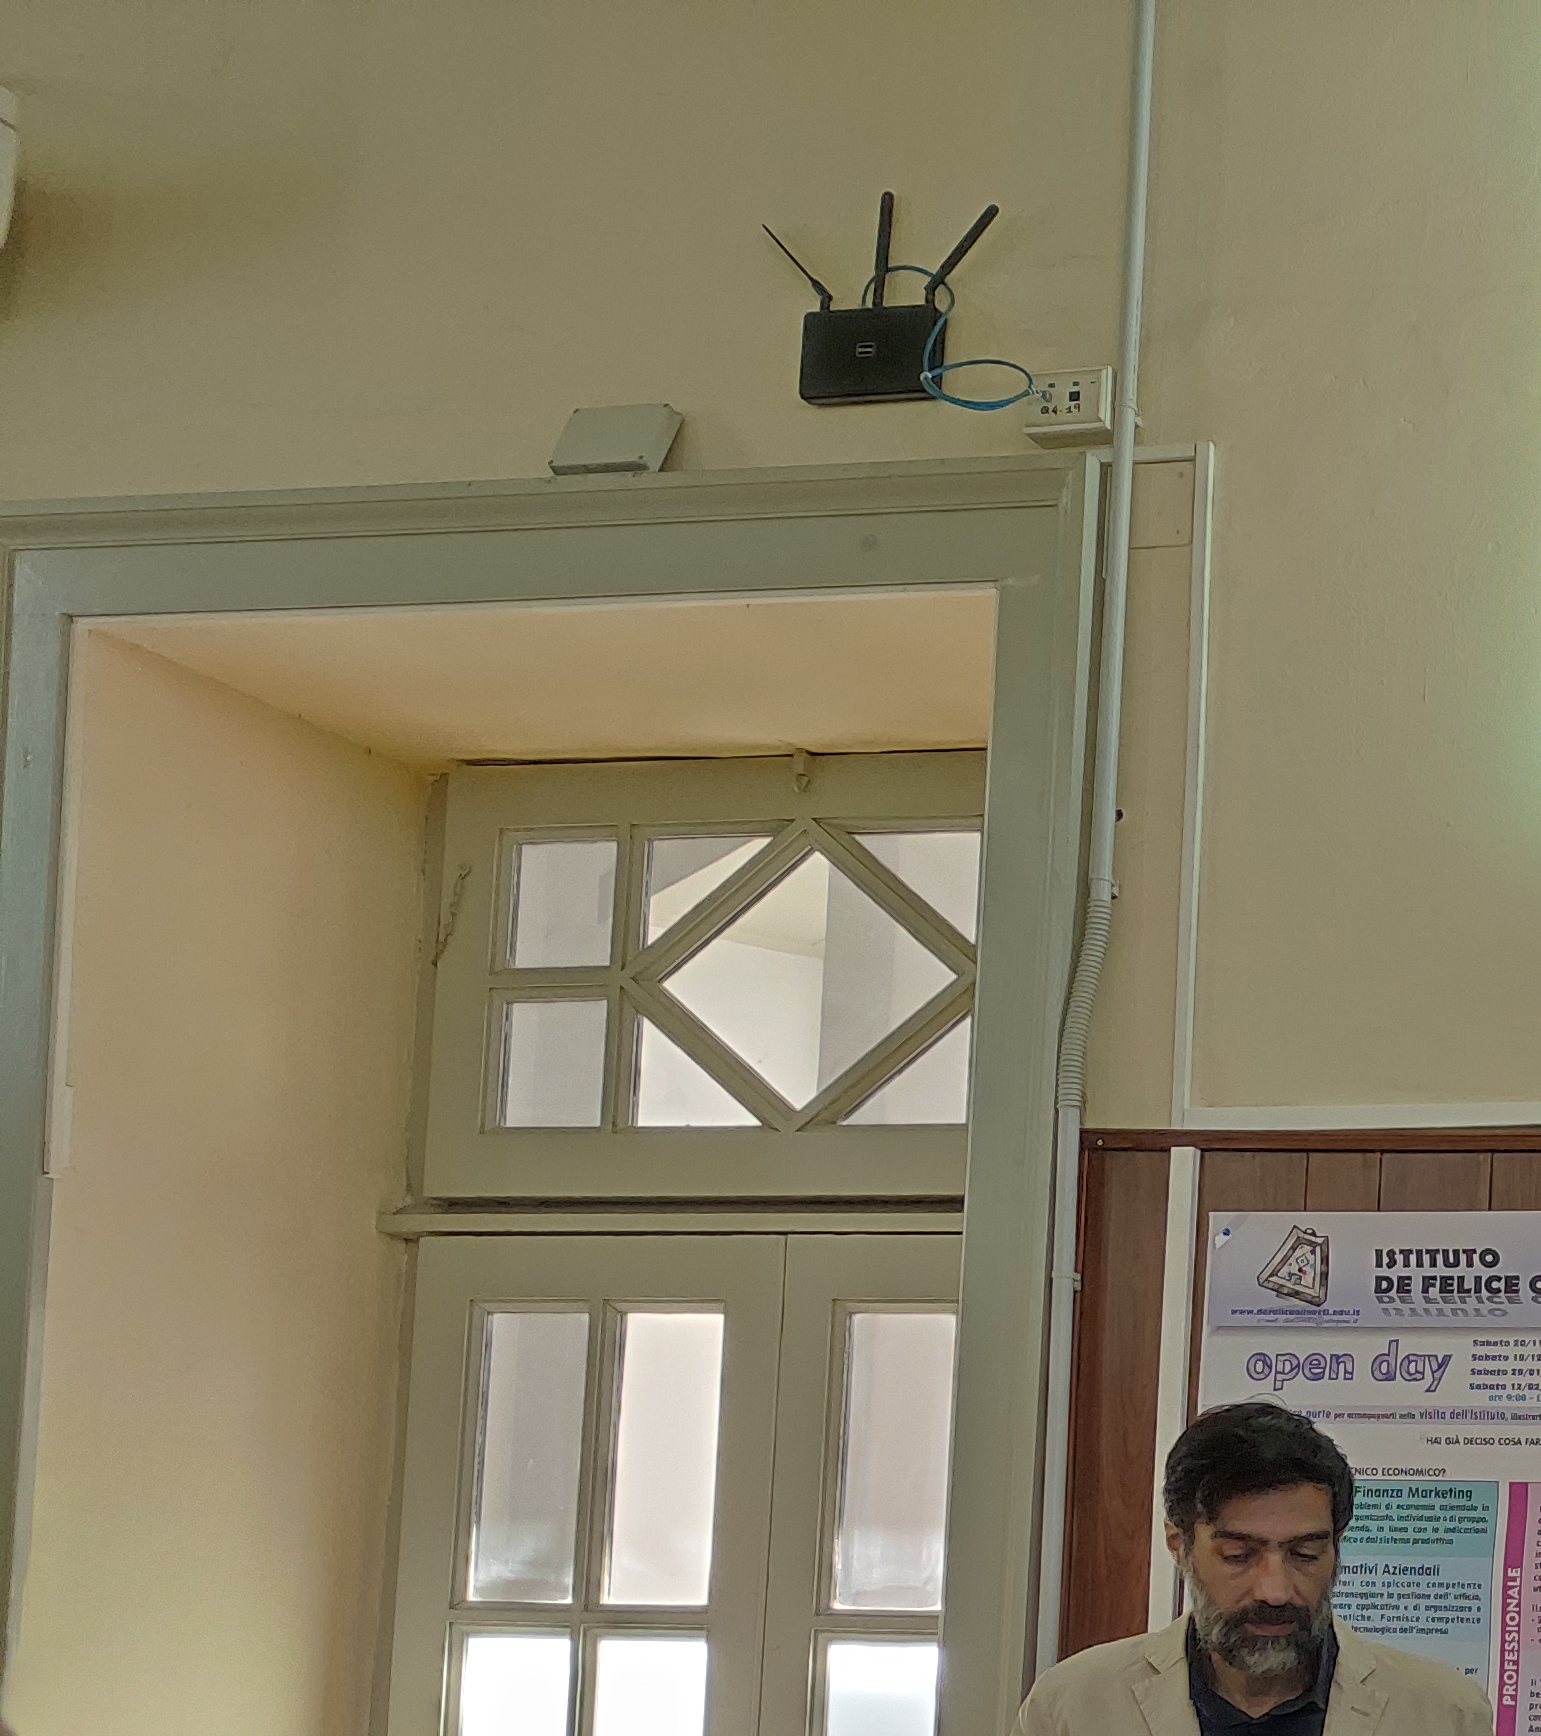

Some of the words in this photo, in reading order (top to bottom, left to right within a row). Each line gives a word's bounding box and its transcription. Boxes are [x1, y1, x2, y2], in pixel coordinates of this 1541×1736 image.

[1374, 1247, 1501, 1269] ISTITUTO
[1373, 1274, 1413, 1295] DE
[1420, 1274, 1521, 1295] FELICE
[1246, 1353, 1355, 1391] open
[1371, 1339, 1453, 1392] day
[1419, 1407, 1446, 1421] visita
[1463, 1437, 1495, 1446] DECISO
[1498, 1437, 1522, 1447] COSA
[1354, 1485, 1403, 1499] Finanza
[1408, 1486, 1473, 1501] Marketing
[1382, 1563, 1440, 1577] Aziendali
[1502, 1566, 1521, 1707] PROFESSIONALE
